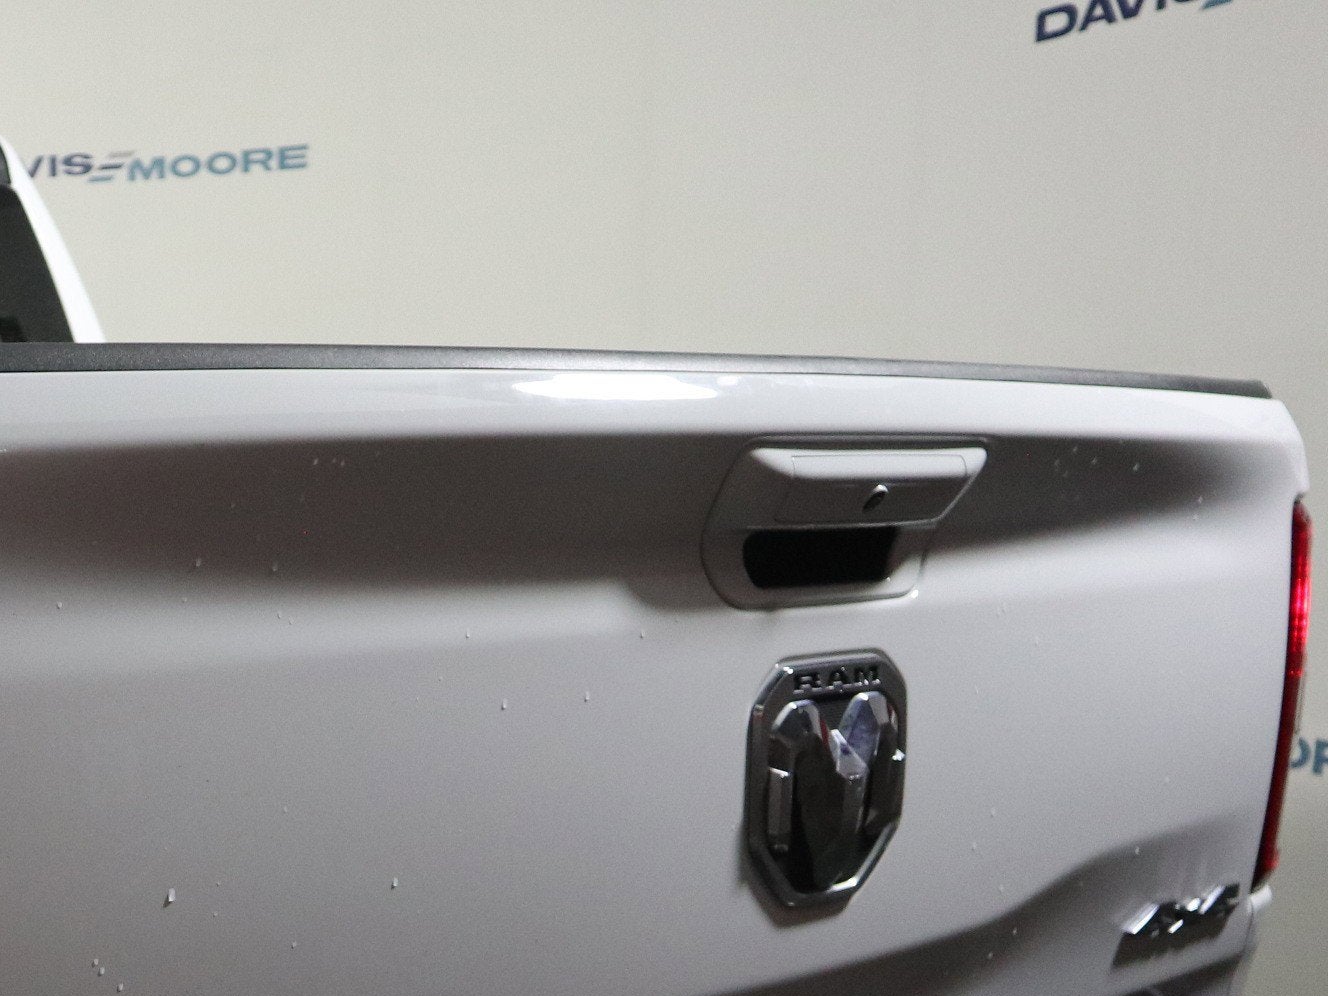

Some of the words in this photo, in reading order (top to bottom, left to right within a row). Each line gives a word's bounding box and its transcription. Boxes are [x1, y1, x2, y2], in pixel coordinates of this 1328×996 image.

[1035, 0, 1190, 42] DAV
[24, 152, 93, 179] VIS
[126, 143, 309, 181] MOORE
[791, 664, 882, 695] RAM
